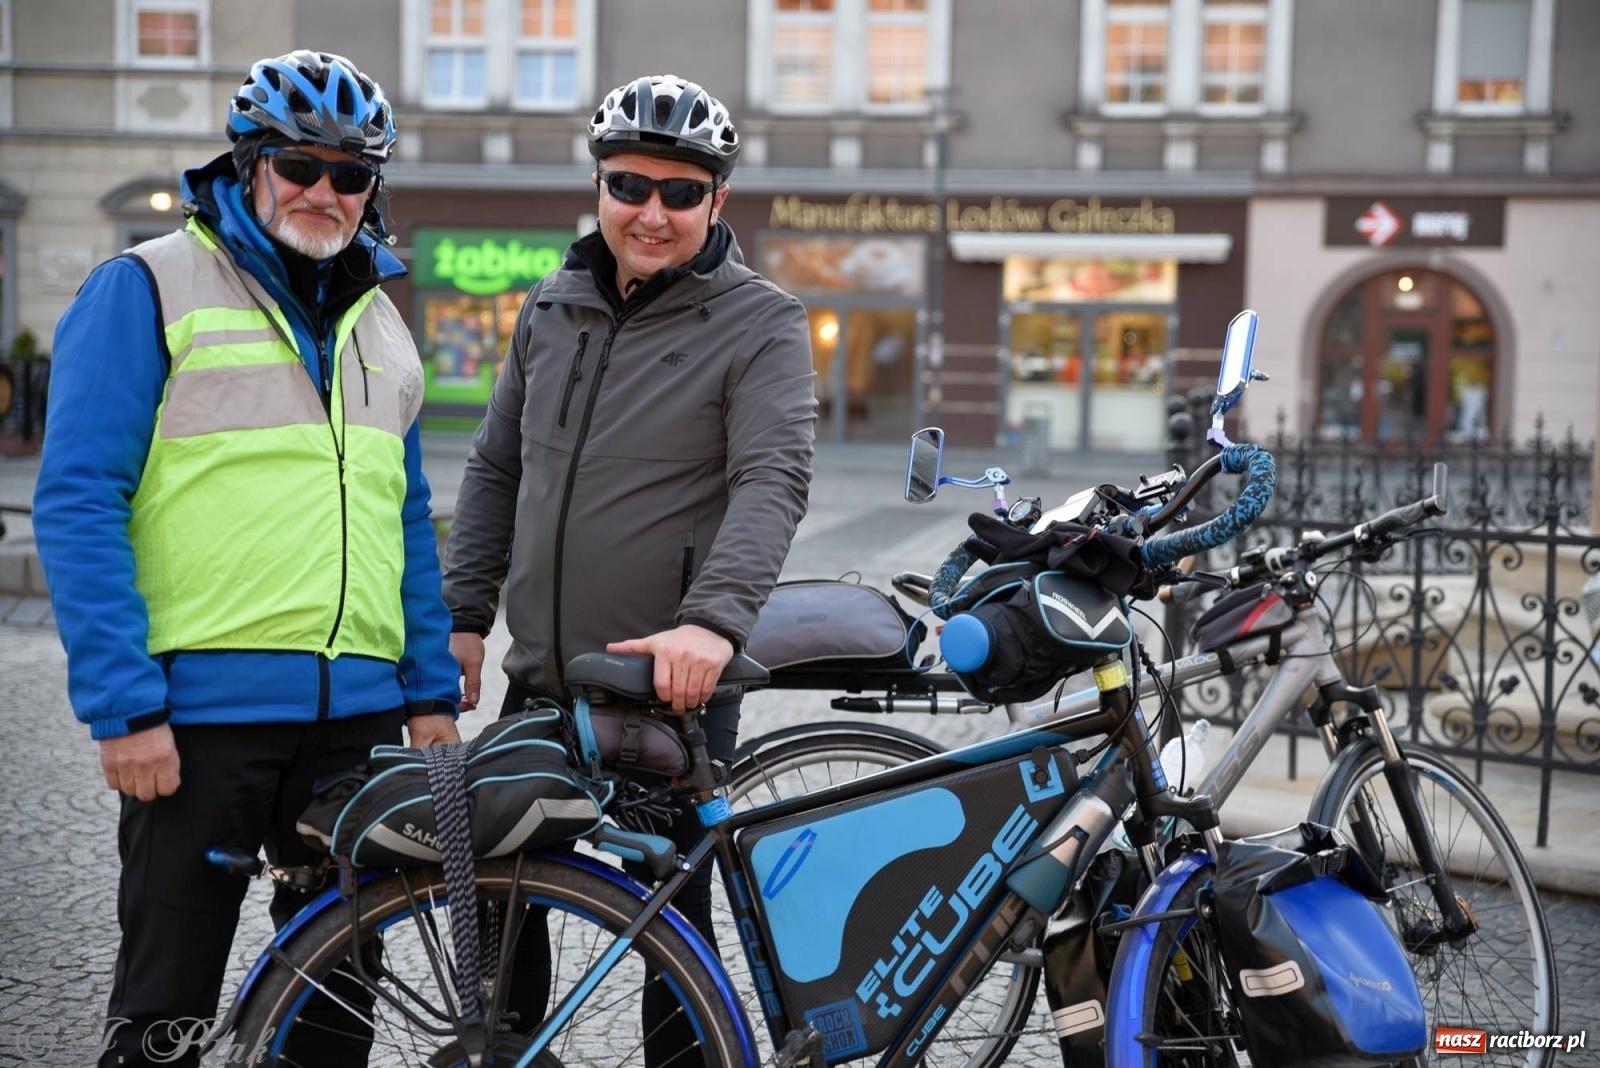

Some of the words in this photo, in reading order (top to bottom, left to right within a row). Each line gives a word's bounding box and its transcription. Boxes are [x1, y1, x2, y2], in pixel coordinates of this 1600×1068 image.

[769, 192, 941, 234] Manufaktura
[946, 196, 1046, 232] Lodów
[660, 351, 688, 366] 4F
[893, 803, 1039, 997] CUBE
[740, 917, 783, 1017] CUBE
[855, 884, 944, 1004] ELITE
[815, 1009, 852, 1034] ROCK
[906, 1003, 947, 1057] CUBE
